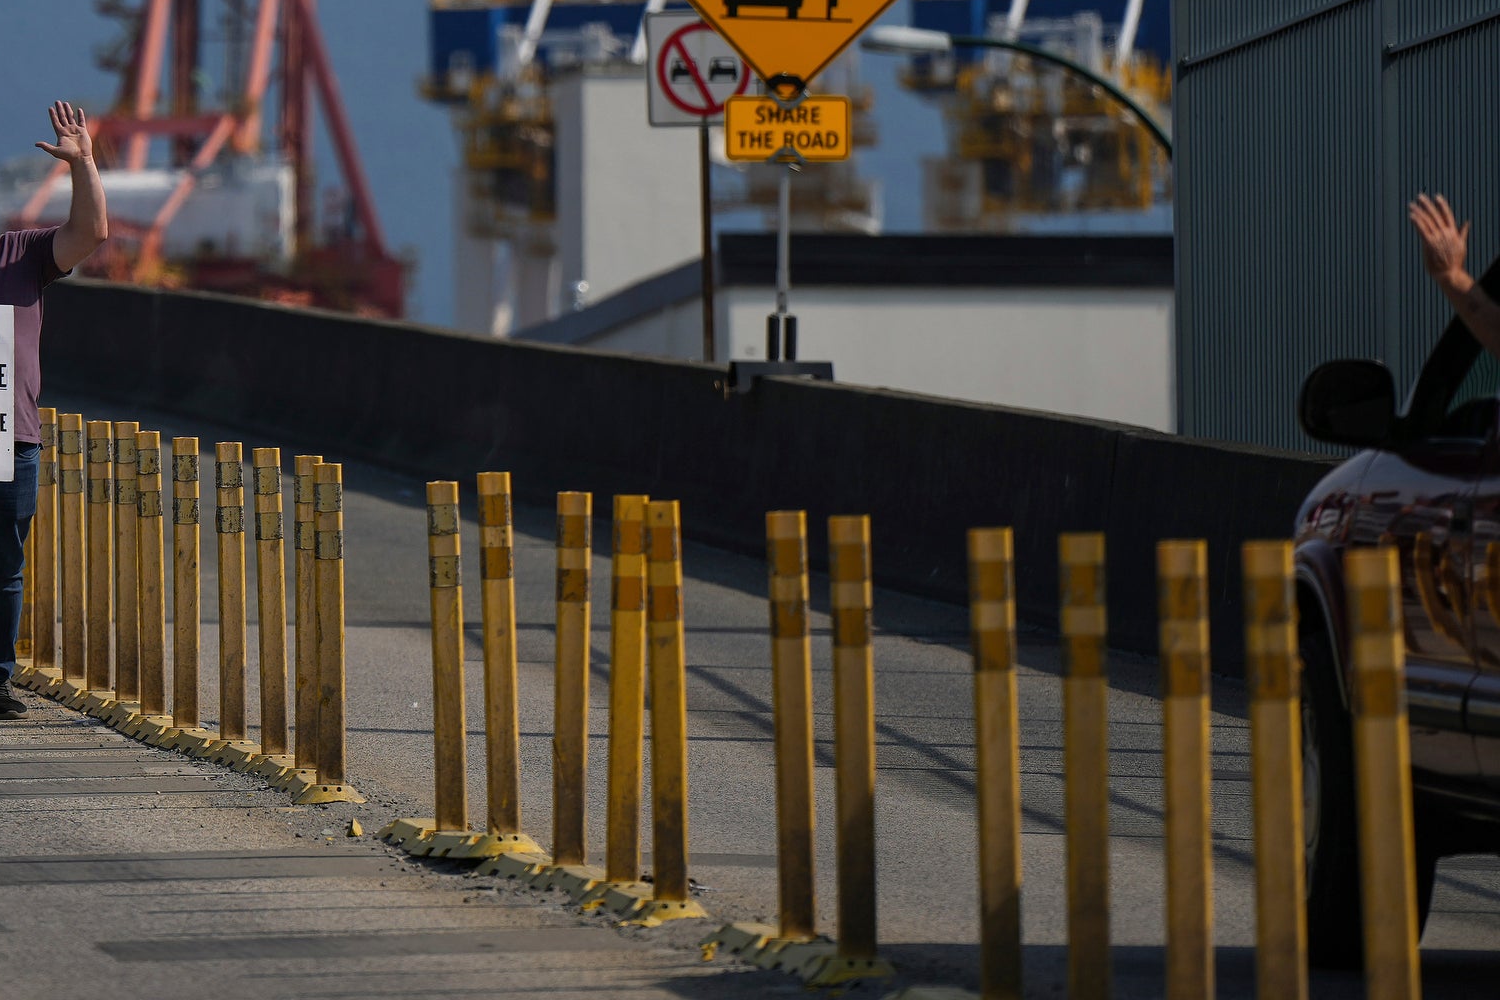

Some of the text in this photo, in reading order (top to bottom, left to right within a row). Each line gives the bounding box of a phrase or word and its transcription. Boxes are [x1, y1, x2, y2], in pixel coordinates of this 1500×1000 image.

[755, 105, 821, 125] SHARE
[737, 131, 839, 149] THE ROAD
